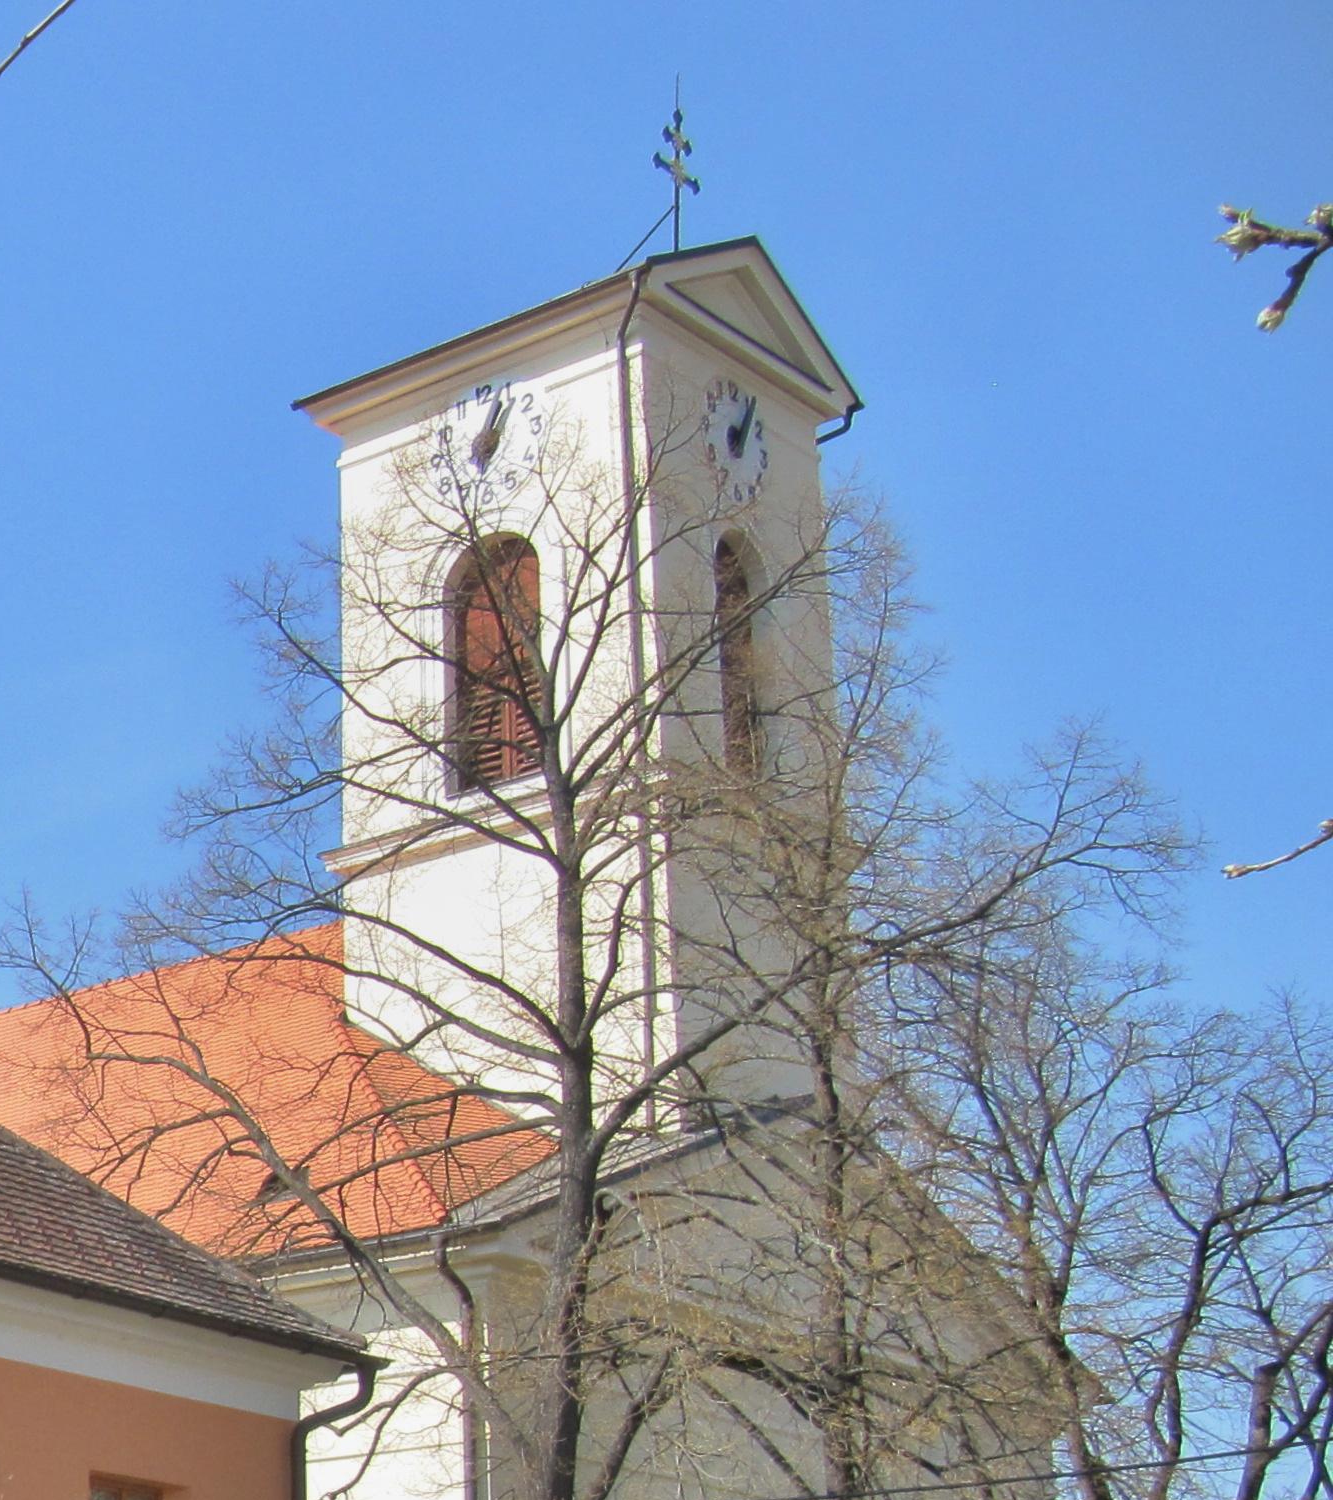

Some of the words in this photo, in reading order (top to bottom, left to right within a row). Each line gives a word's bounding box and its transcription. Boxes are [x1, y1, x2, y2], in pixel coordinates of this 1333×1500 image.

[475, 384, 494, 406] 12
[520, 393, 534, 413] 2
[455, 400, 467, 420] 11
[530, 414, 542, 435] 3
[523, 445, 535, 463] 4
[438, 477, 452, 496] 8
[504, 470, 518, 490] 5
[482, 485, 494, 505] 6
